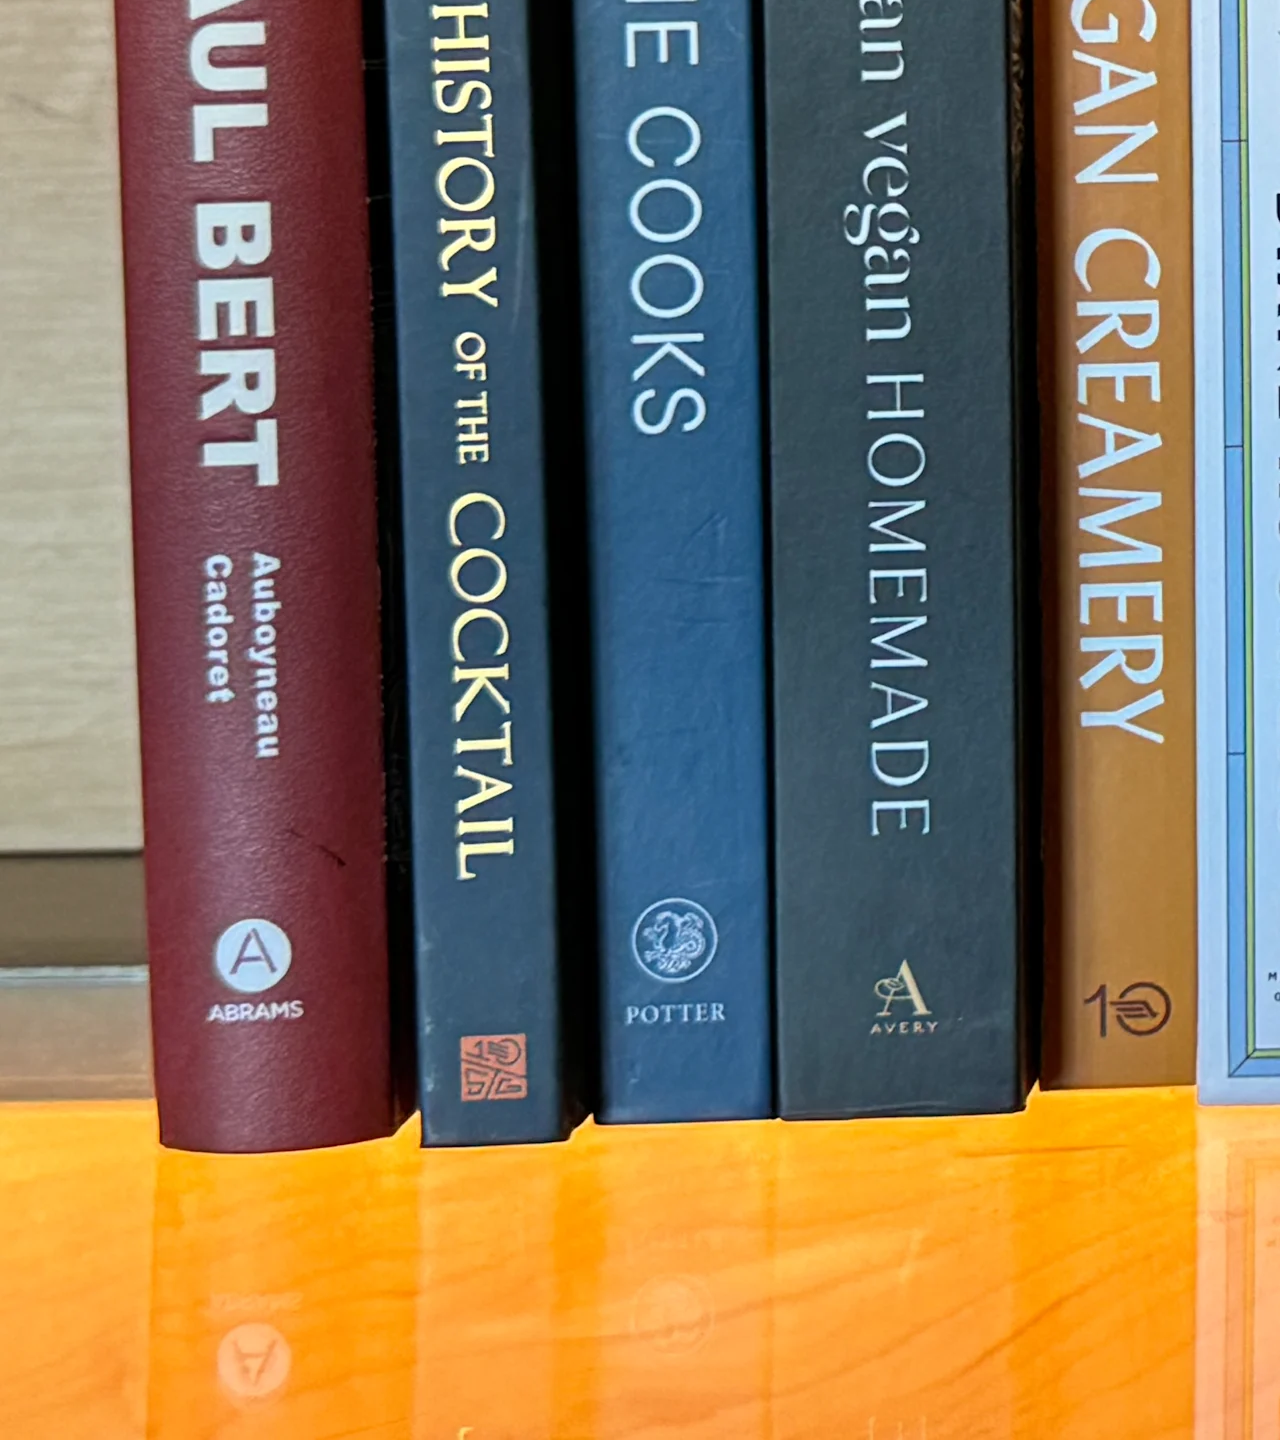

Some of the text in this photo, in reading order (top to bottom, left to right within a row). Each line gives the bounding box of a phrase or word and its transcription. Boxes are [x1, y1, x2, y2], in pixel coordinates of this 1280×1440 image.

[431, 2, 499, 308] HISTORY
[844, 112, 921, 343] vegan
[194, 201, 280, 486] BERT
[454, 331, 487, 380] OF
[626, 106, 707, 435] COOKS
[455, 390, 490, 465] THE
[1074, 227, 1165, 744] CREAMERY
[203, 554, 235, 703] Cadoret
[249, 551, 283, 759] Auboyneau
[448, 491, 516, 881] COCKTAIL
[866, 372, 930, 837] HOMEMADE
[206, 999, 305, 1021] ABRAMS
[625, 1002, 726, 1024] POTTER
[870, 1021, 939, 1034] AVERY
